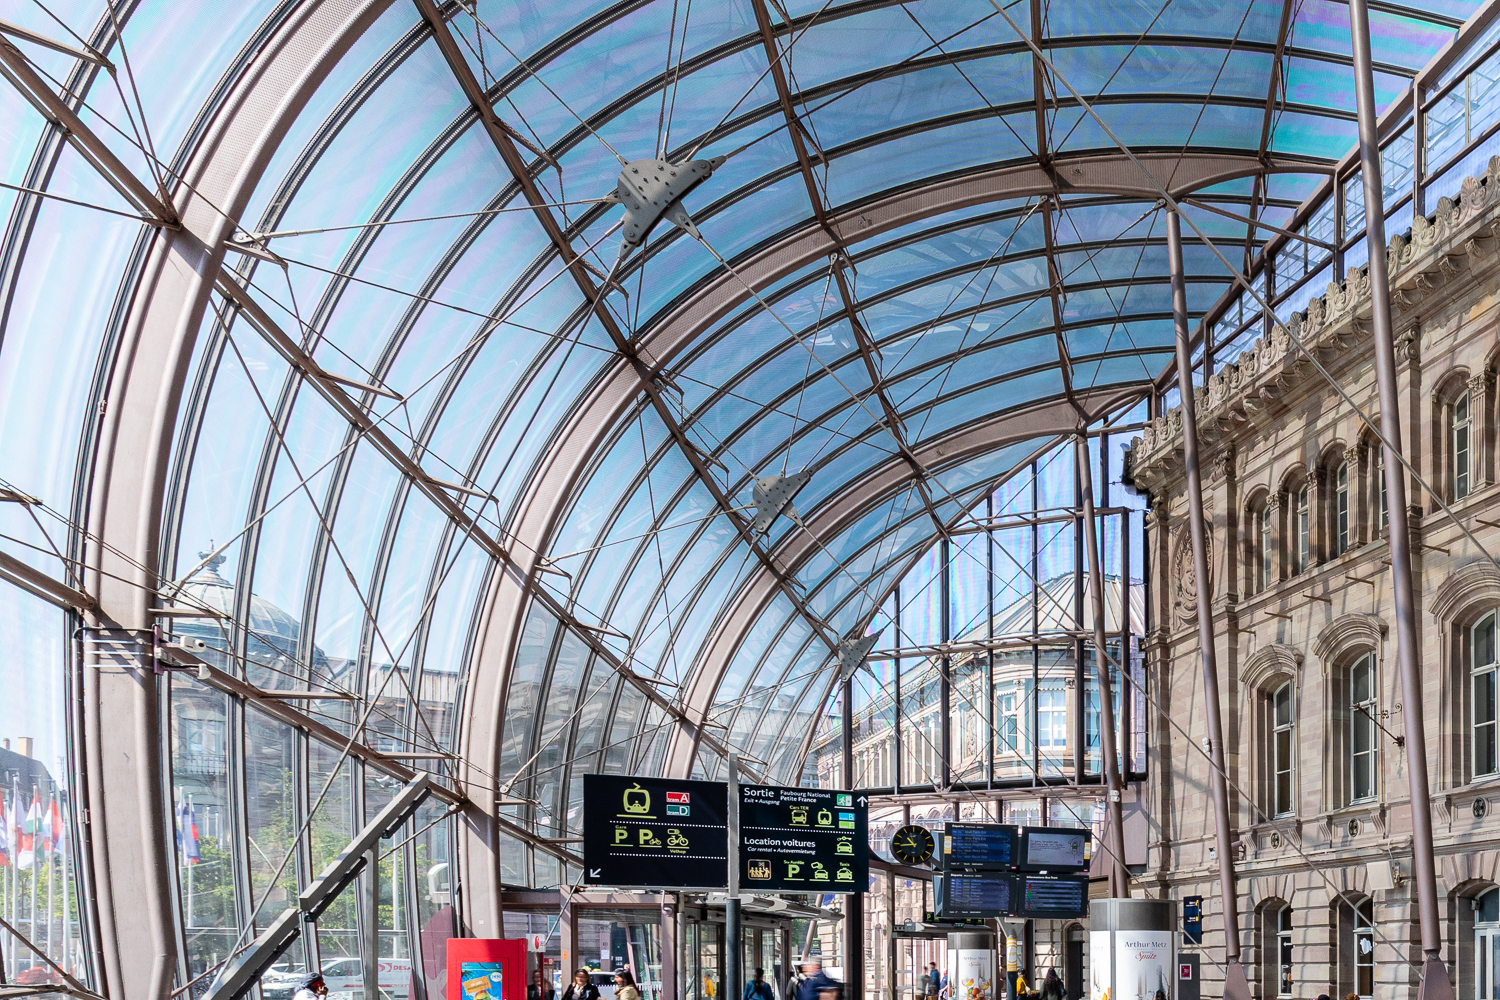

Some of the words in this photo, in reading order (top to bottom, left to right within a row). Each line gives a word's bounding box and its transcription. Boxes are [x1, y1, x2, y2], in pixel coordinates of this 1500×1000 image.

[744, 787, 775, 797] Sortie
[780, 790, 806, 798] Faubourg
[807, 791, 831, 799] National
[680, 793, 690, 803] A
[680, 806, 688, 815] D
[615, 829, 628, 844] P
[639, 829, 653, 845] P
[744, 836, 781, 847] Location
[782, 839, 816, 848] voitures
[788, 864, 800, 878] P
